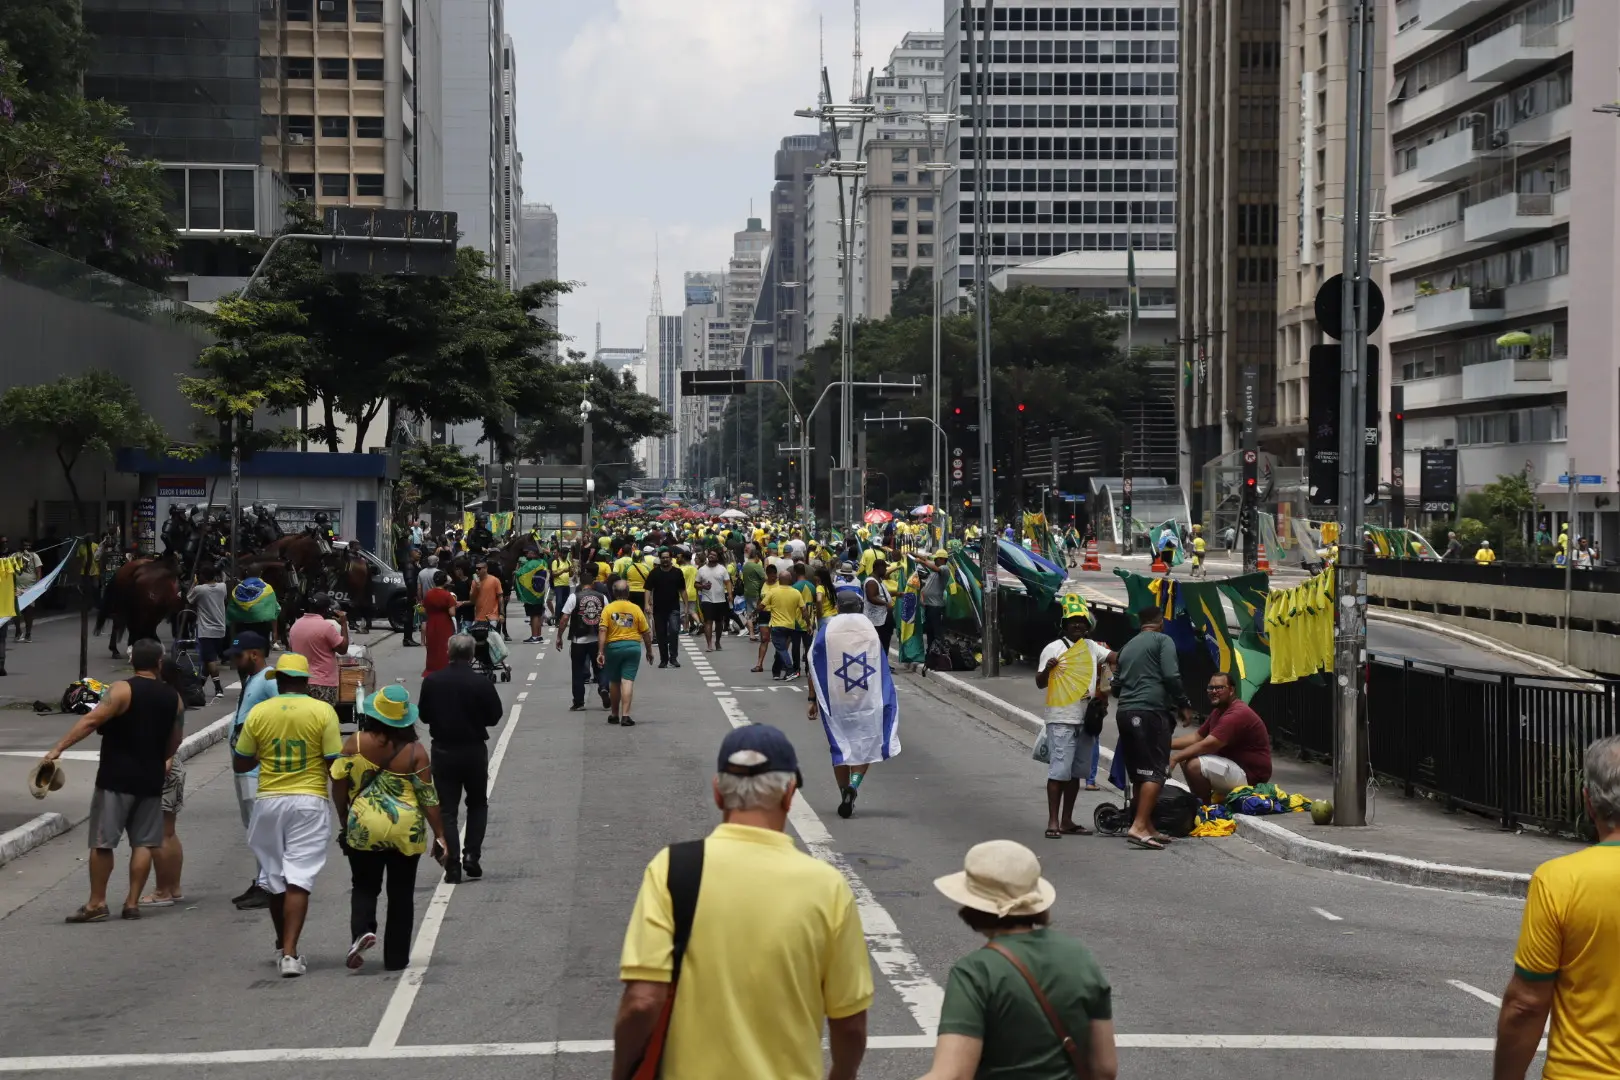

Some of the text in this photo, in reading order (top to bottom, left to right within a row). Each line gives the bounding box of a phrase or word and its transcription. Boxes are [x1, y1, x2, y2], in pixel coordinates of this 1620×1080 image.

[1245, 385, 1255, 423] Augusta
[1425, 502, 1449, 512] 29°C
[272, 738, 307, 773] 10
